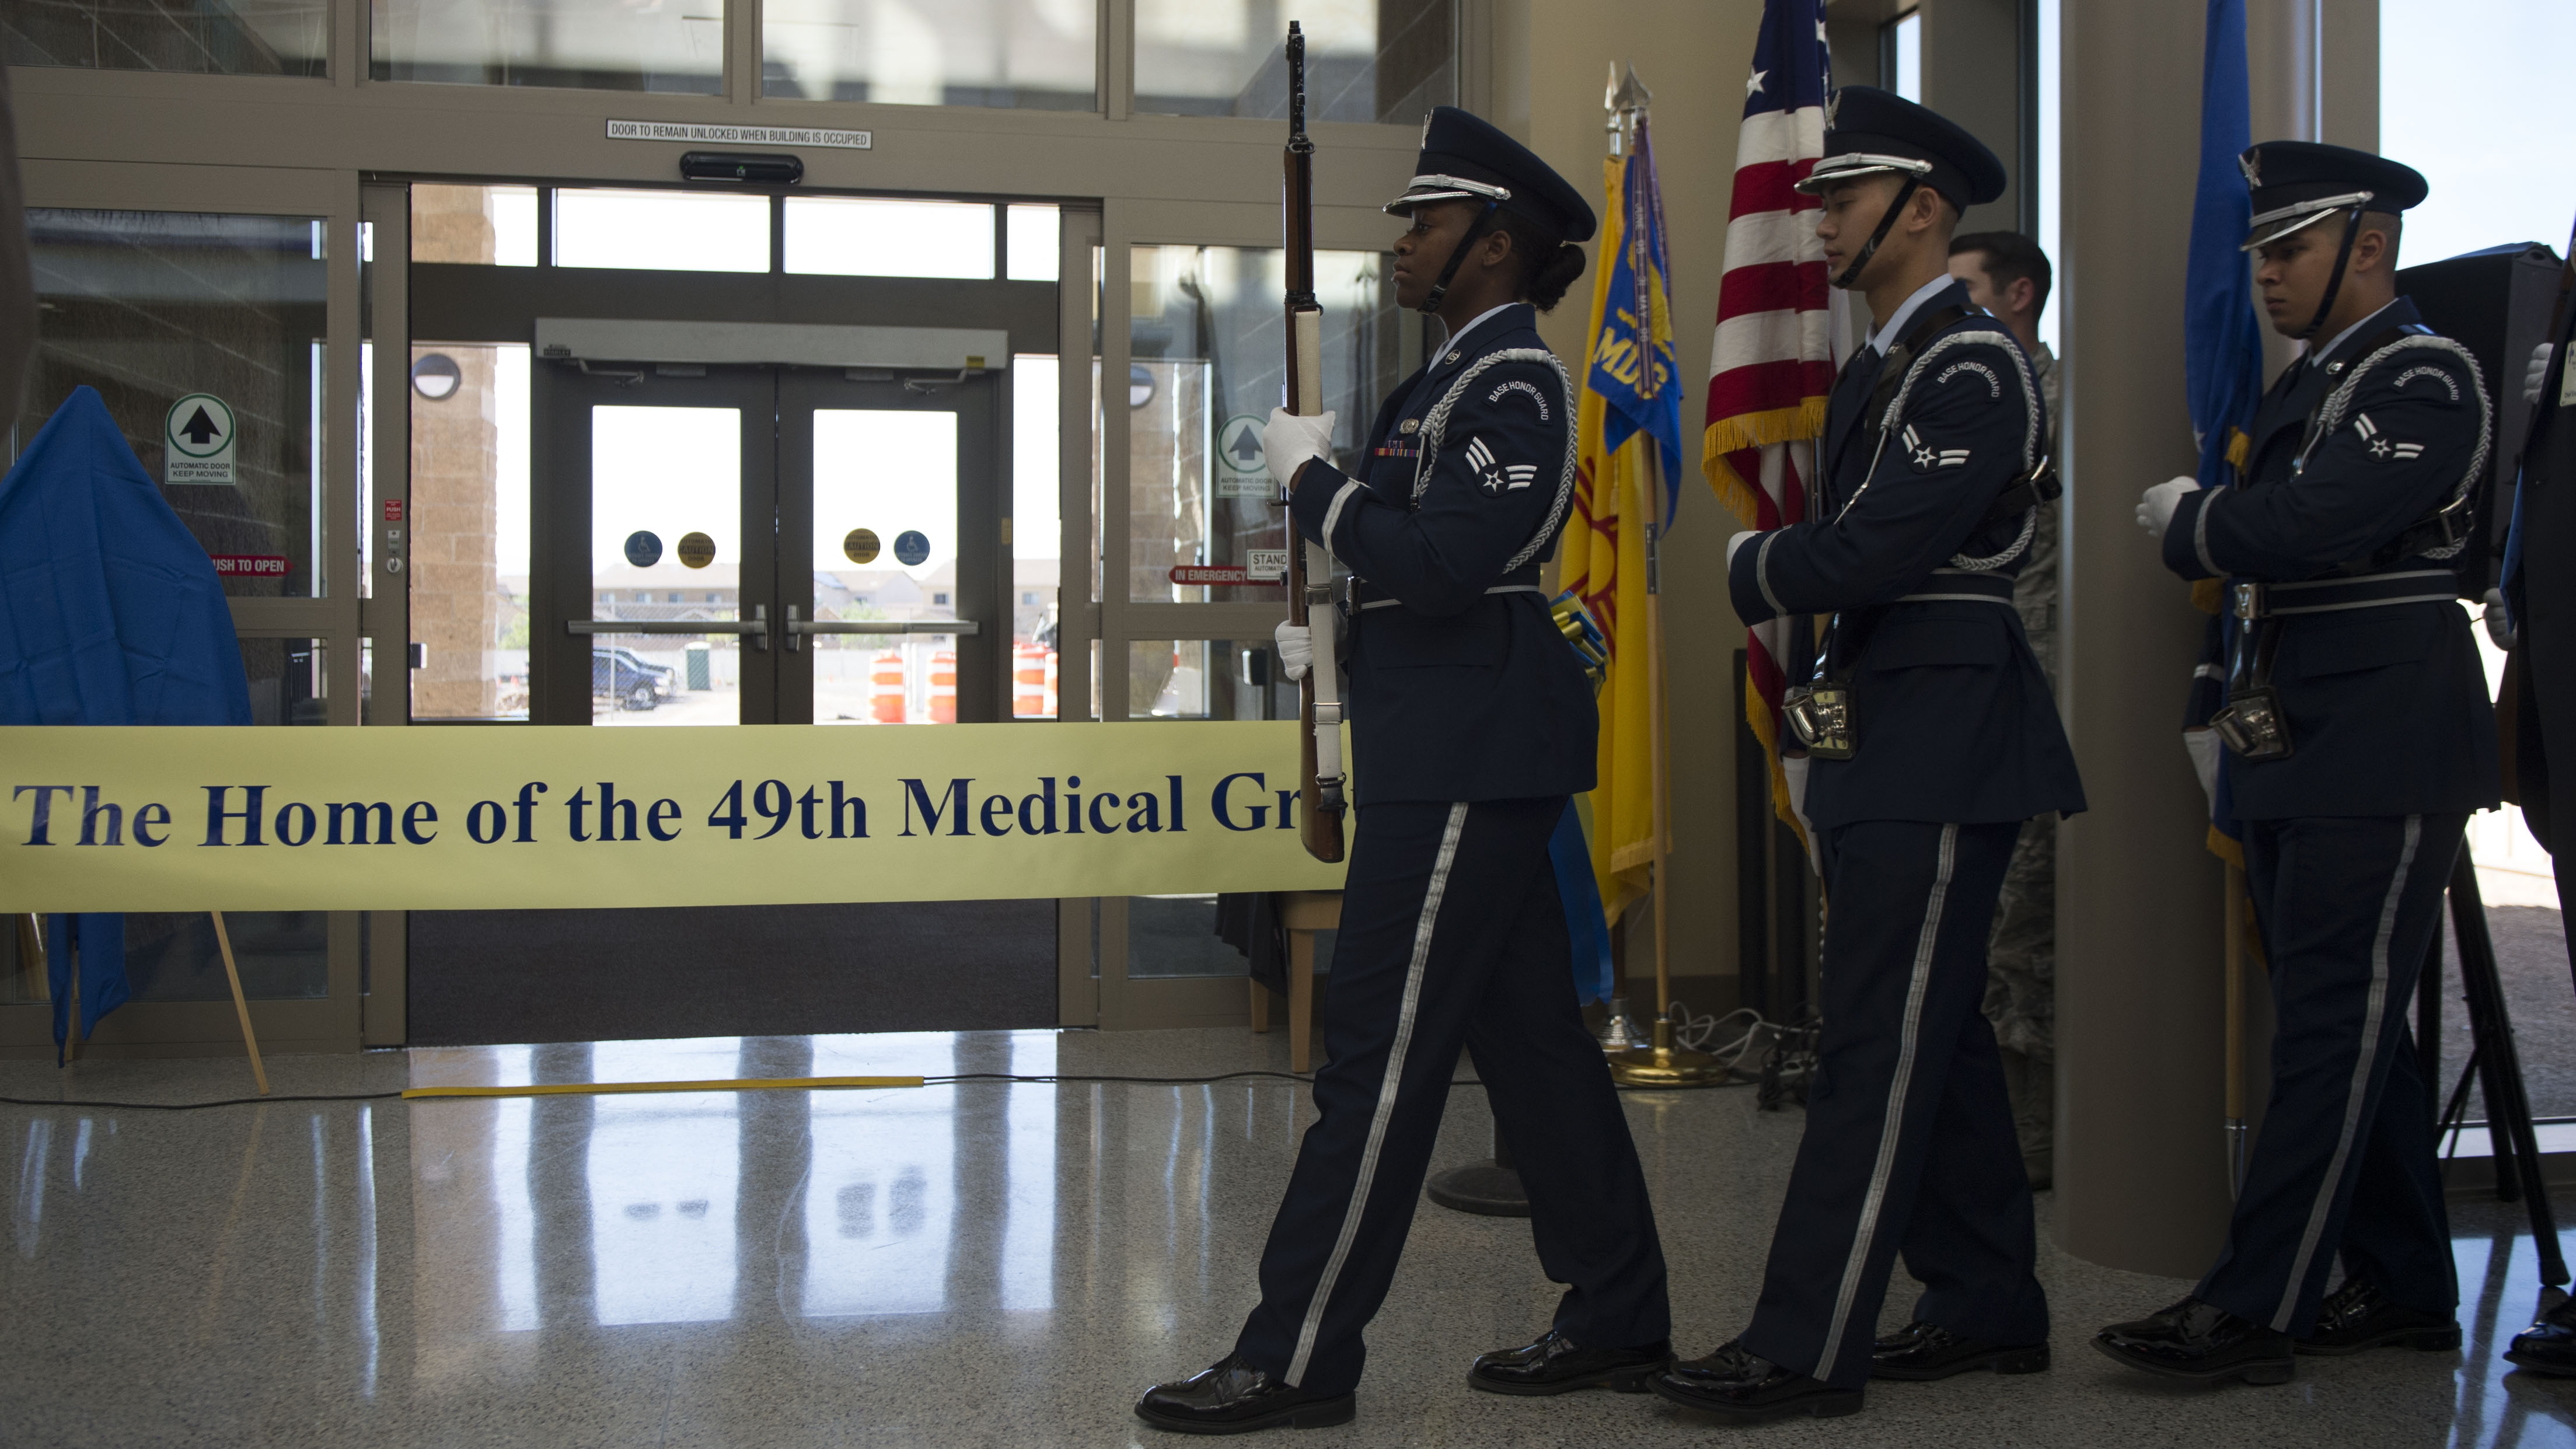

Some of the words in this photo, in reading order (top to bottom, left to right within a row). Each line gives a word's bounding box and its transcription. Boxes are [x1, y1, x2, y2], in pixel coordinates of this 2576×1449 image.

[612, 123, 637, 136] DOOR
[640, 125, 650, 136] TO
[653, 125, 688, 138] REMAIN
[691, 127, 738, 140] UNLOCKED
[740, 129, 766, 141] WHEN
[769, 130, 810, 143] BUILDING
[813, 132, 821, 143] IS
[823, 132, 867, 145] OCCUPIED
[1638, 295, 1647, 318] MAY
[1937, 365, 1959, 384] BASE
[1957, 361, 1988, 374] HONOR
[1984, 370, 1999, 397] GUARD
[2393, 369, 2416, 387] BASE
[2414, 366, 2445, 379] HONOR
[2442, 374, 2459, 400] GUARD
[1488, 383, 1510, 402] BASE
[1508, 380, 1537, 396] HONOR
[1534, 392, 1549, 420] GUARD
[212, 559, 235, 571] USH
[238, 559, 252, 571] TO
[254, 560, 284, 572] OPEN
[1253, 554, 1287, 564] STAND
[1175, 570, 1185, 580] IN
[1188, 570, 1246, 582] EMERGENCY
[13, 785, 171, 847] The
[197, 785, 438, 847] Home
[466, 781, 548, 844] of
[564, 782, 682, 842] the
[708, 779, 871, 840] 49th
[897, 775, 1188, 837] Medical
[1211, 772, 1353, 832] Gr
